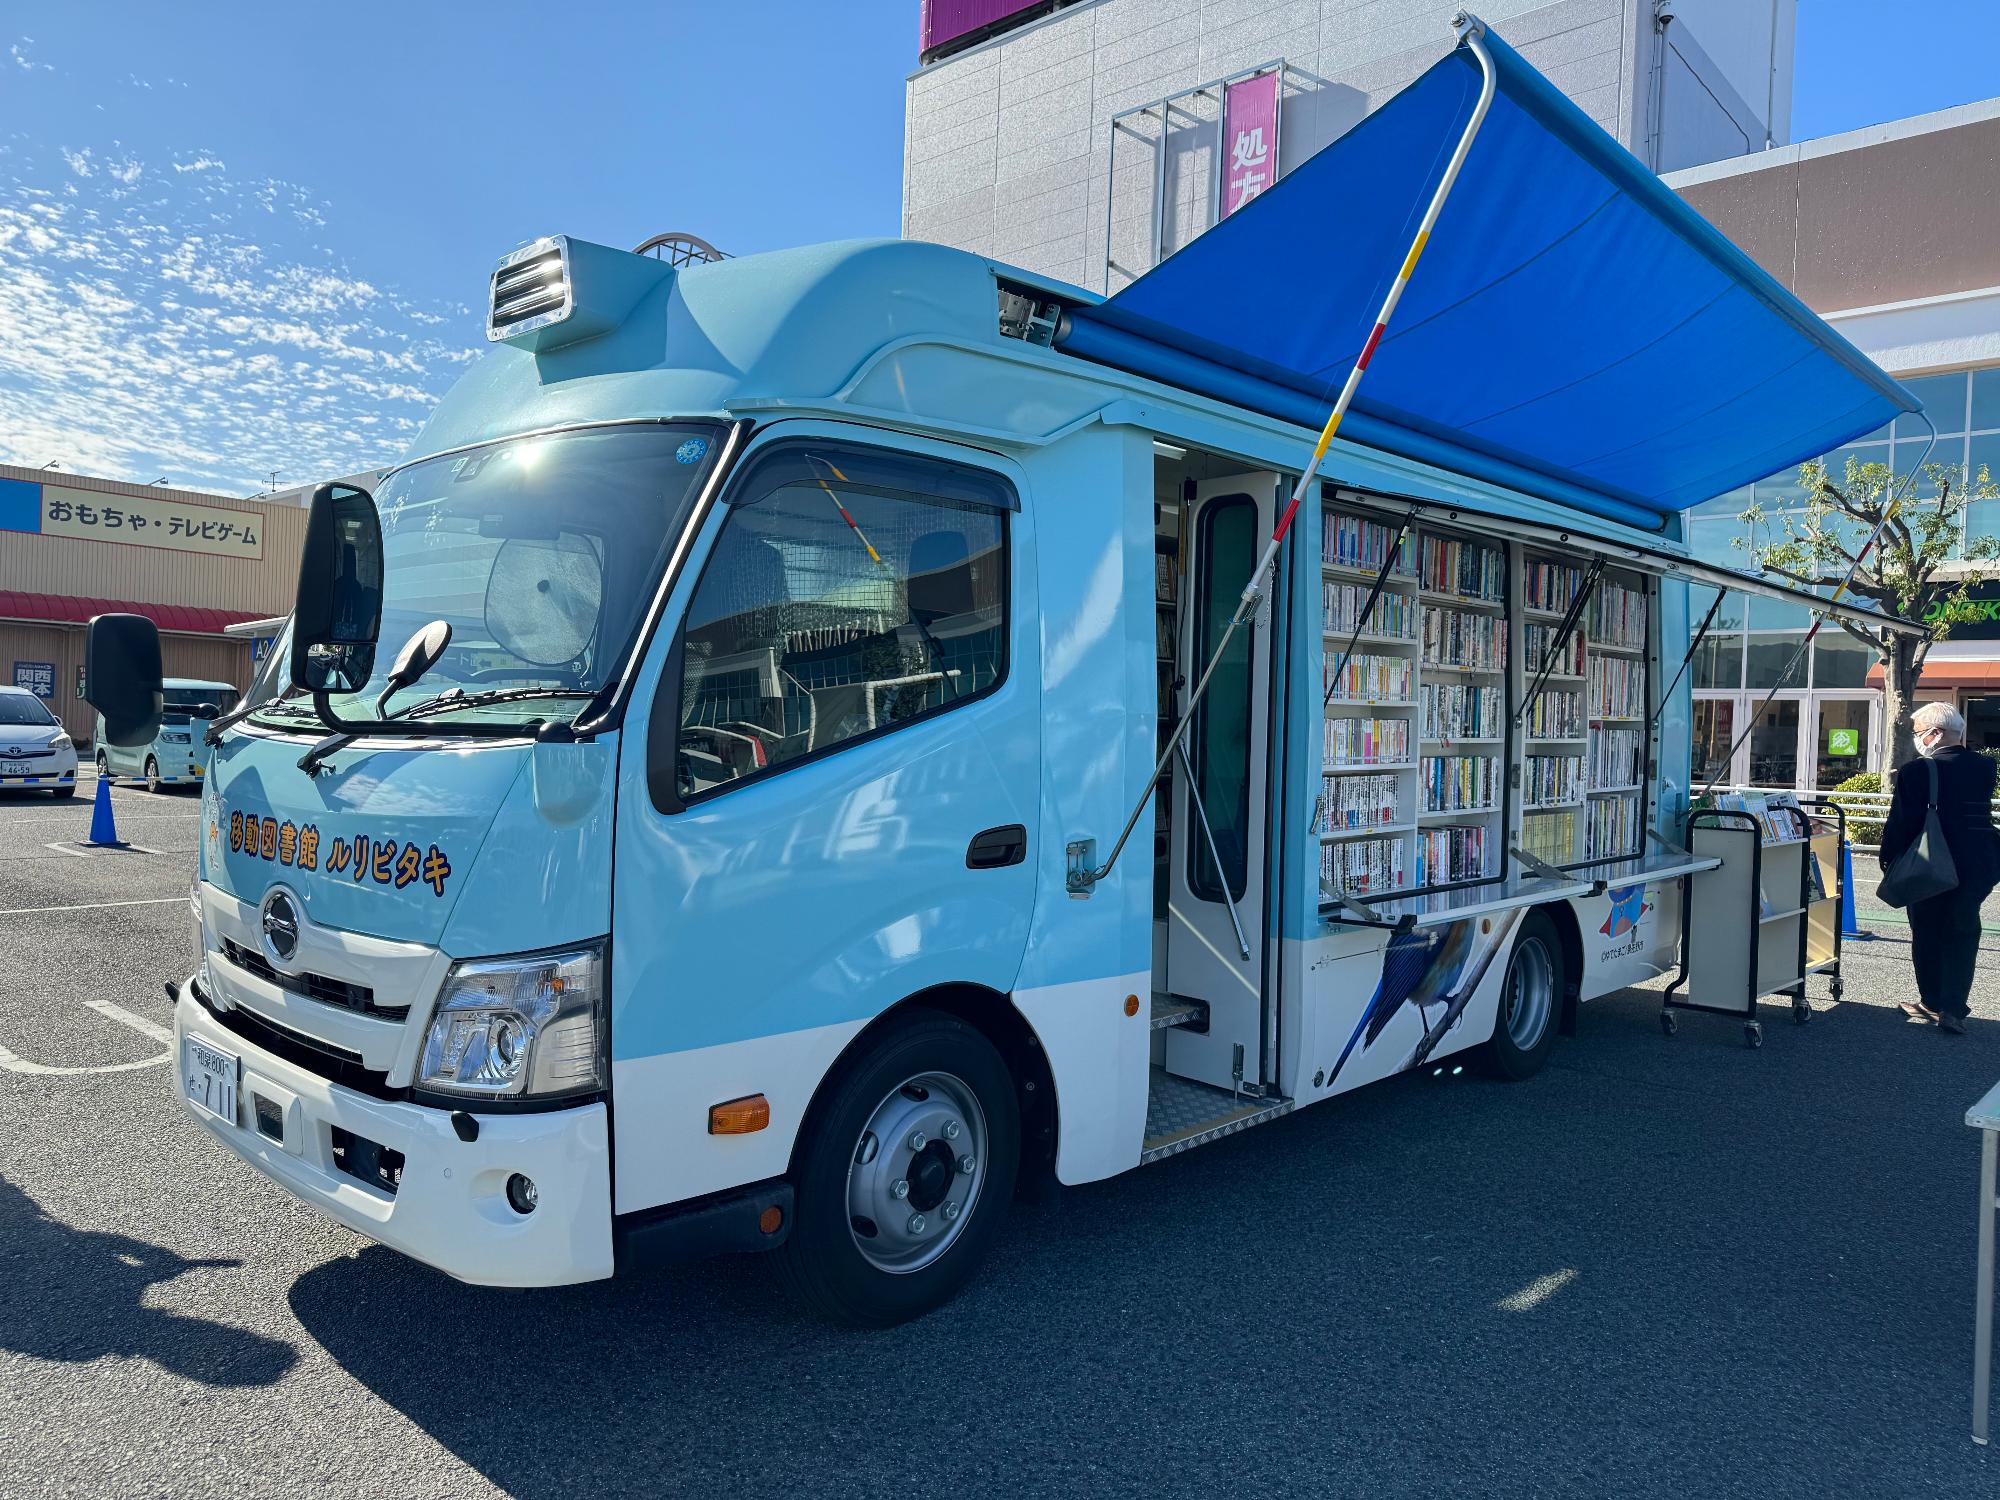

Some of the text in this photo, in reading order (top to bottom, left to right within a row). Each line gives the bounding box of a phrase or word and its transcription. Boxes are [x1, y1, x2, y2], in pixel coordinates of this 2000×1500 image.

[48, 500, 258, 546] おもちゃ・テレビゲーム
[17, 668, 52, 683] 関西
[229, 810, 451, 898] 移動図書館 ルリビタキ
